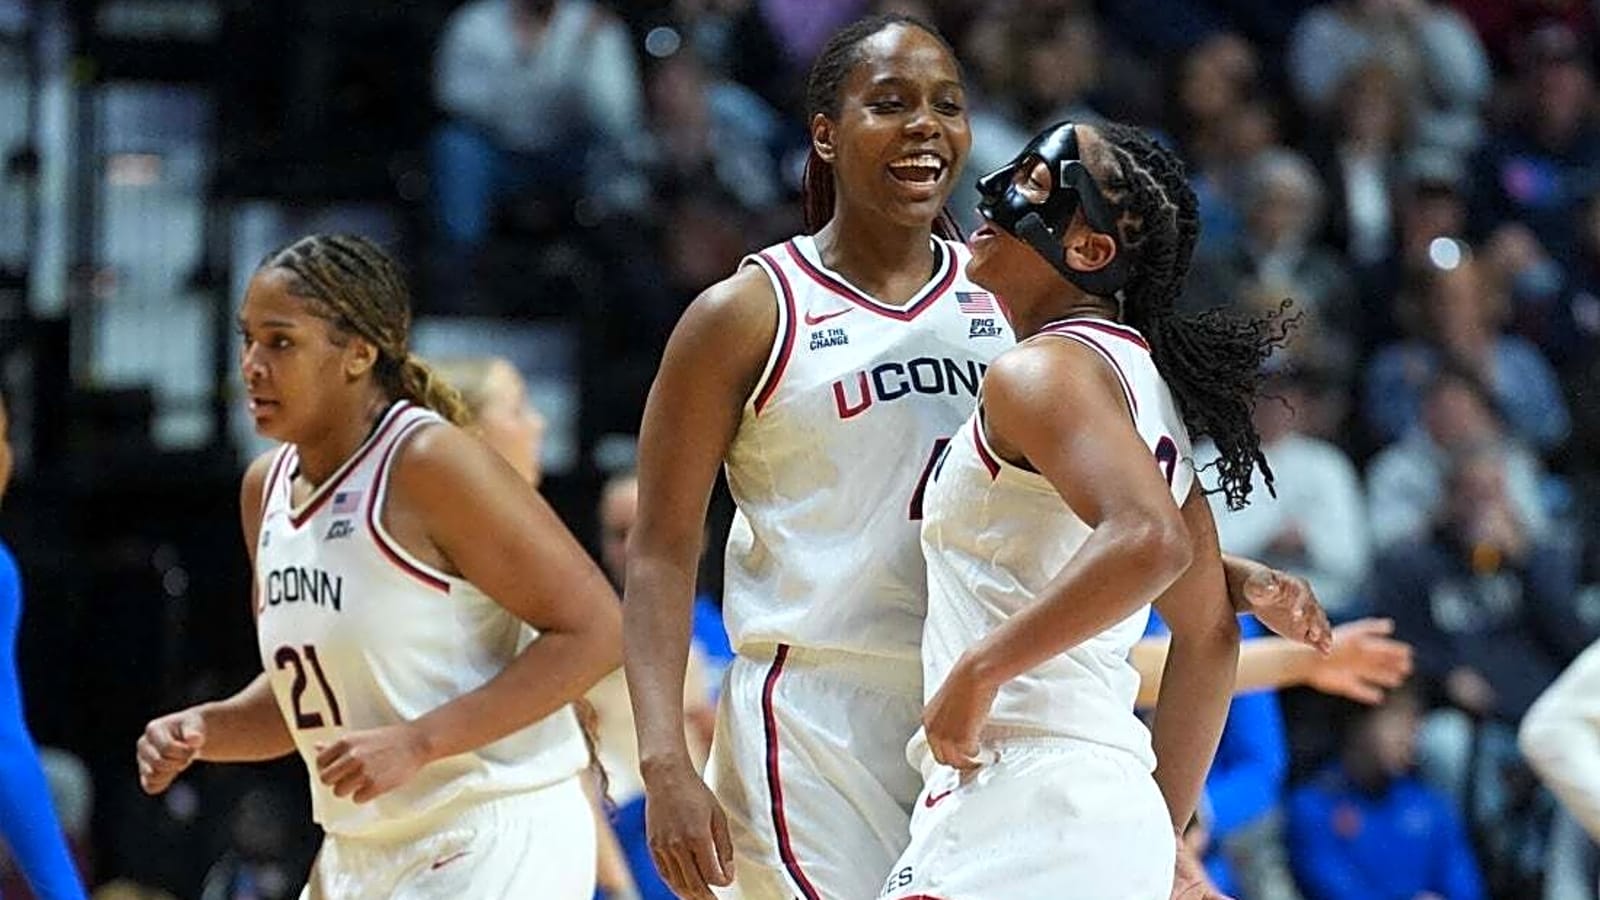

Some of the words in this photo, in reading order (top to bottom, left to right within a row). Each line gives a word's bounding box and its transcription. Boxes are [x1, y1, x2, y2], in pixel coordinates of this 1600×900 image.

[971, 318, 995, 327] BIG
[811, 330, 824, 340] BE
[827, 328, 845, 337] THE
[969, 327, 1002, 336] EAST
[809, 335, 849, 350] CHANGE
[274, 645, 342, 729] 21
